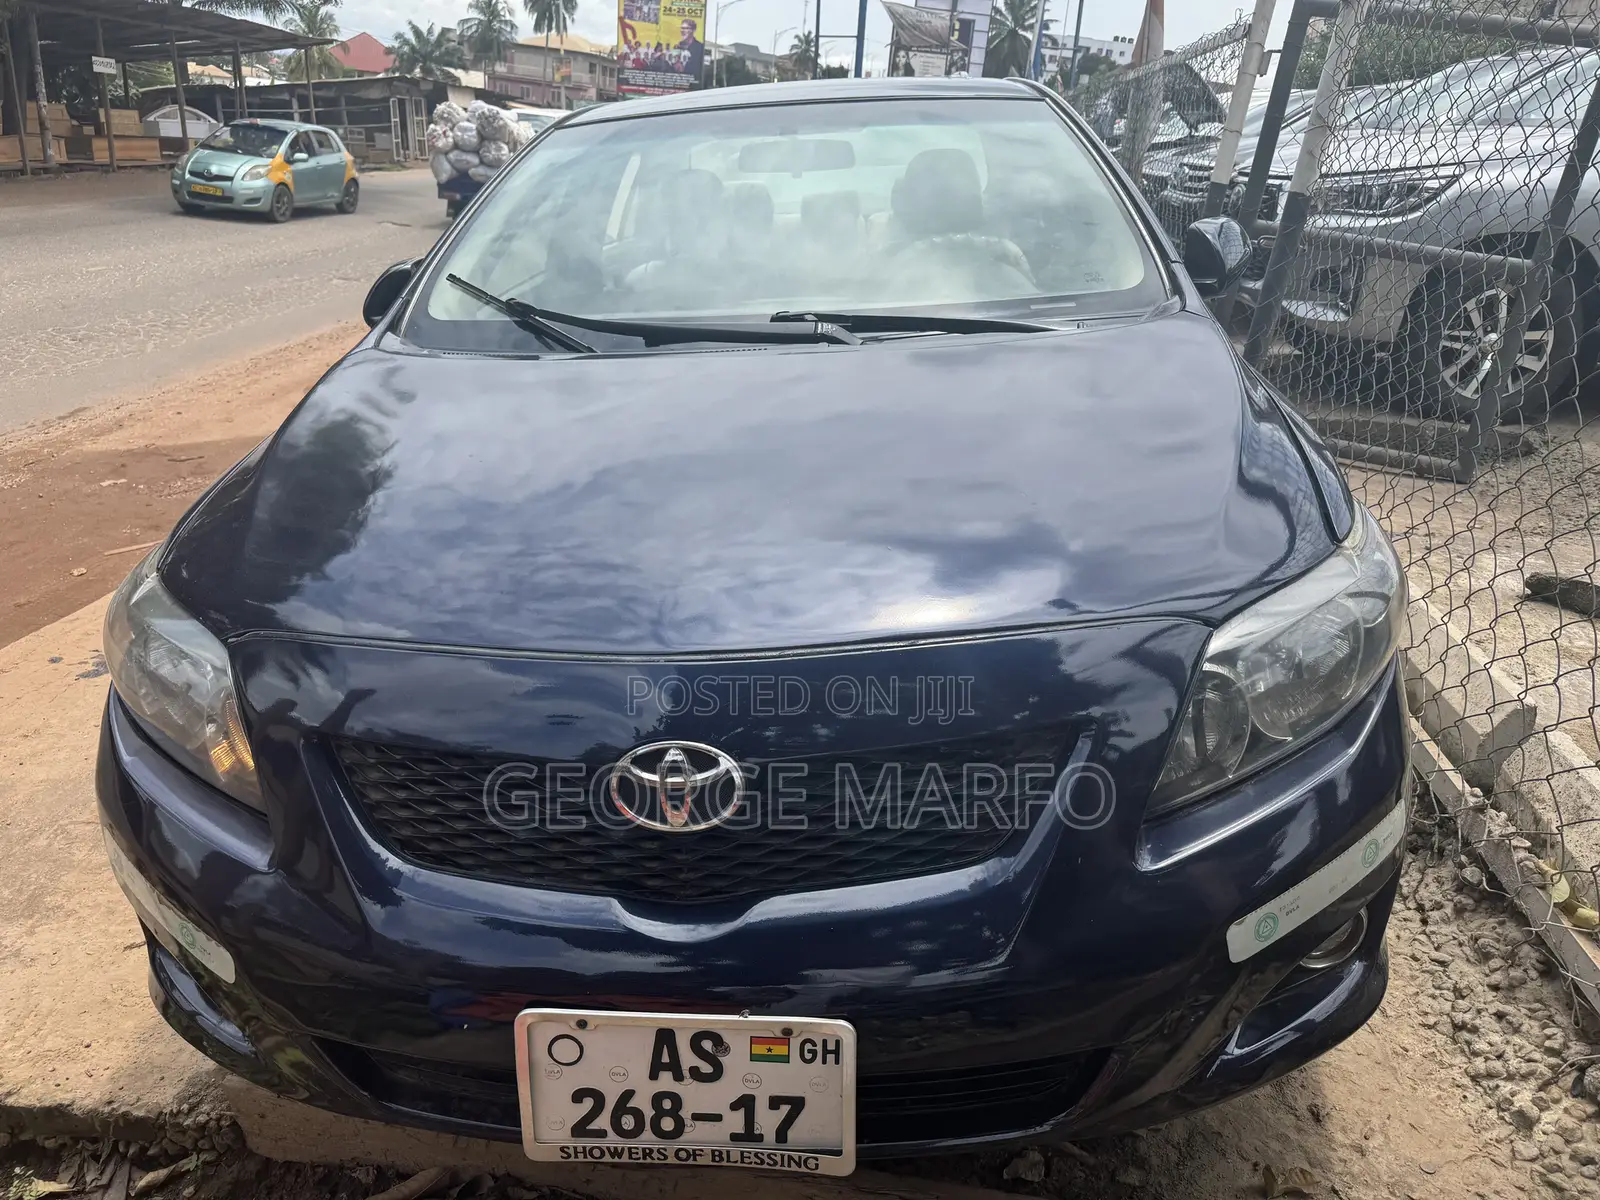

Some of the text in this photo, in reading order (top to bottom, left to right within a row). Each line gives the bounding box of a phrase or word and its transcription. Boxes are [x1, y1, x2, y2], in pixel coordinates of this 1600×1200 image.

[687, 8, 704, 16] OCT
[648, 1028, 724, 1084] AS
[799, 1038, 841, 1066] GH
[570, 1087, 806, 1144] 268-17
[559, 1145, 820, 1172] SHOWERS OF BLESSING
